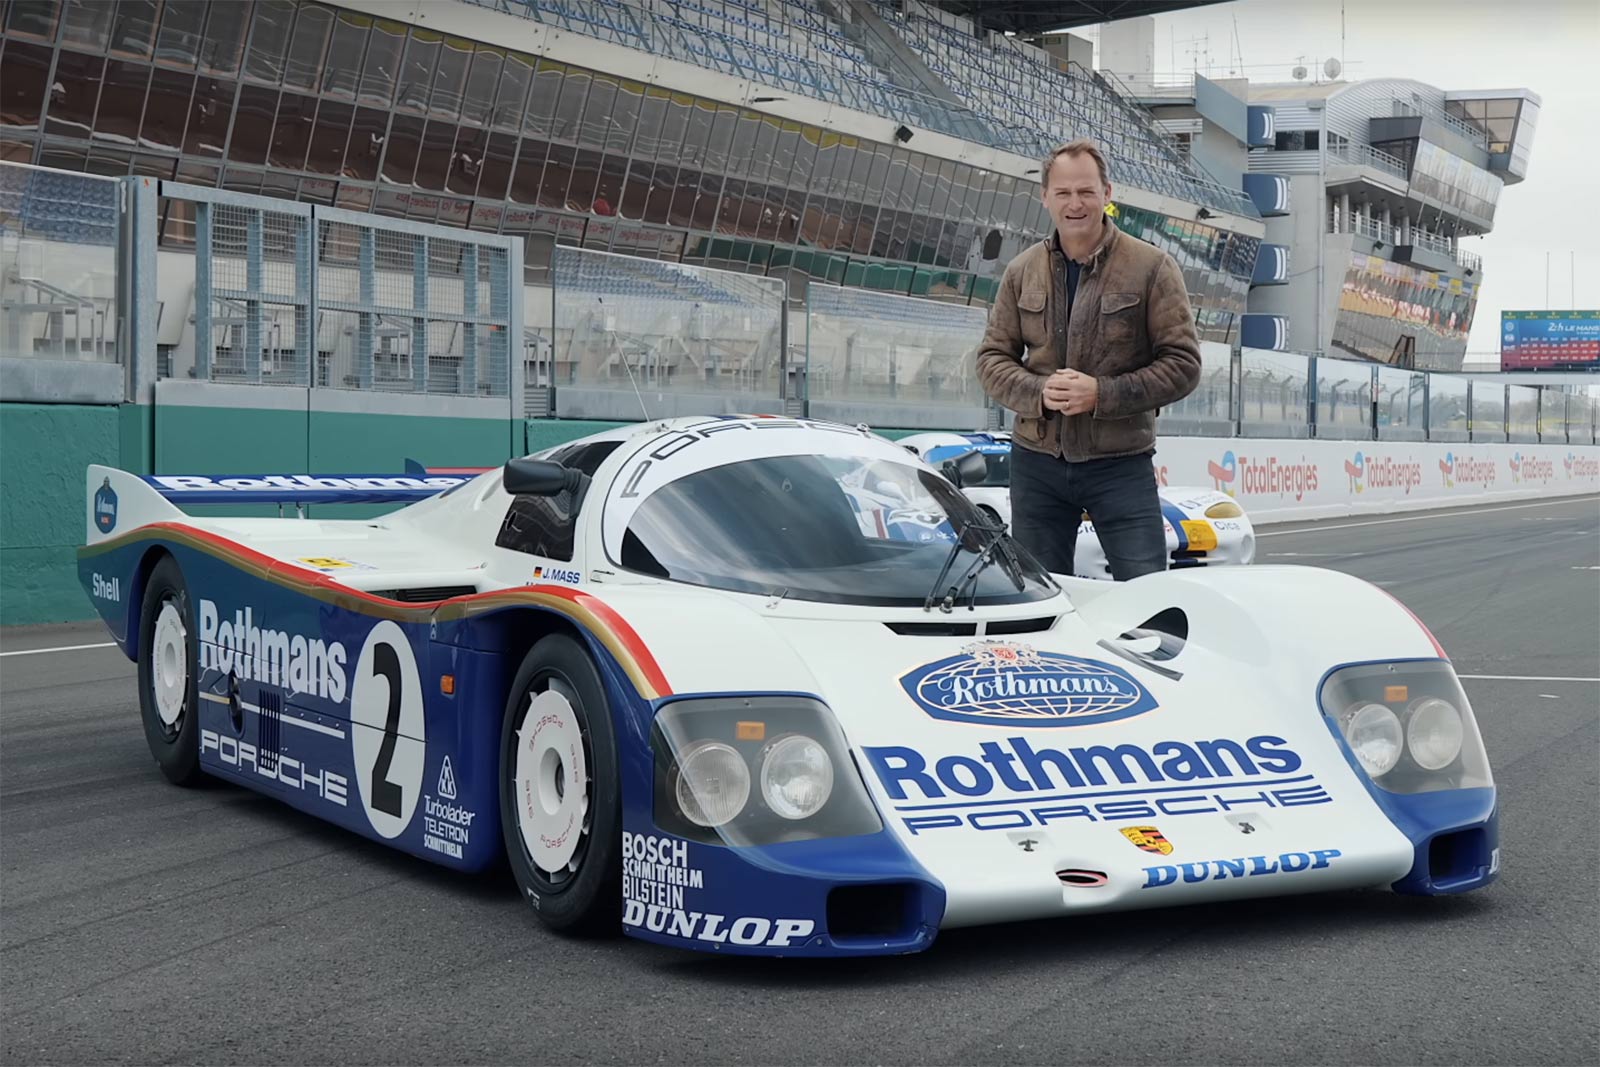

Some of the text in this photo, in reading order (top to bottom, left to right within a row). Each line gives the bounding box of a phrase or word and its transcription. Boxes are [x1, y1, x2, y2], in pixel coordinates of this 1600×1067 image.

[1239, 456, 1318, 501] TotalEnergies
[1365, 456, 1421, 494] TotalEnergies
[1455, 456, 1496, 488] TotalEnergies
[93, 573, 120, 602] Shell
[200, 598, 347, 704] Rothmans
[937, 671, 1133, 706] Rothmans
[371, 641, 402, 819] 2
[202, 730, 347, 806] PORSCHE
[861, 735, 1303, 801] Rothmans
[424, 795, 476, 826] Turbolader
[901, 785, 1334, 835] PORSCHE
[424, 816, 469, 844] TELETRON
[622, 832, 688, 868] BOSCH
[1142, 849, 1342, 889] DUNLOP
[622, 857, 704, 889] SCHMITTHELM
[622, 875, 684, 910] BILSTEIN
[622, 899, 815, 947] DUNLOP
